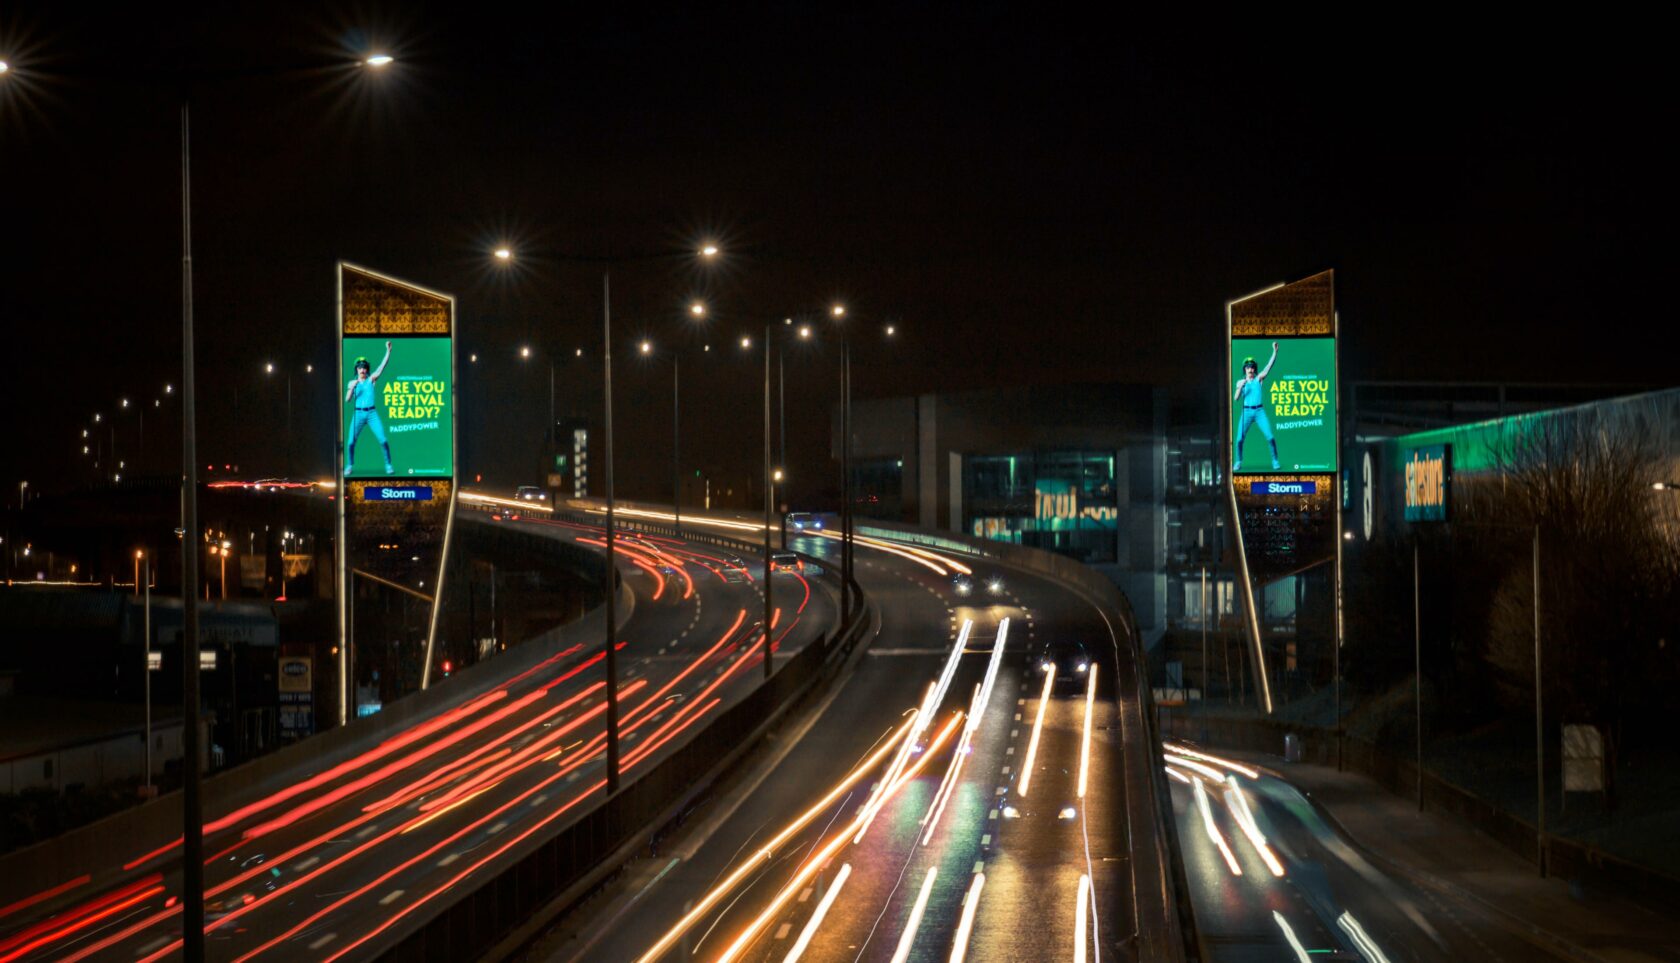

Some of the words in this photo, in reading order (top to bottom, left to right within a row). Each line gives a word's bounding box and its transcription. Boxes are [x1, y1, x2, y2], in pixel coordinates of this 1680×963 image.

[383, 381, 410, 394] ARE
[413, 381, 445, 394] YOU
[1270, 380, 1295, 393] ARE
[1298, 380, 1329, 392] YOU
[384, 394, 446, 406] FESTIVAL
[1271, 392, 1329, 405] FESTIVAL
[388, 406, 441, 419] READY?
[1275, 404, 1325, 417] READY?
[381, 488, 416, 499] Storm
[1268, 483, 1303, 494] Storm
